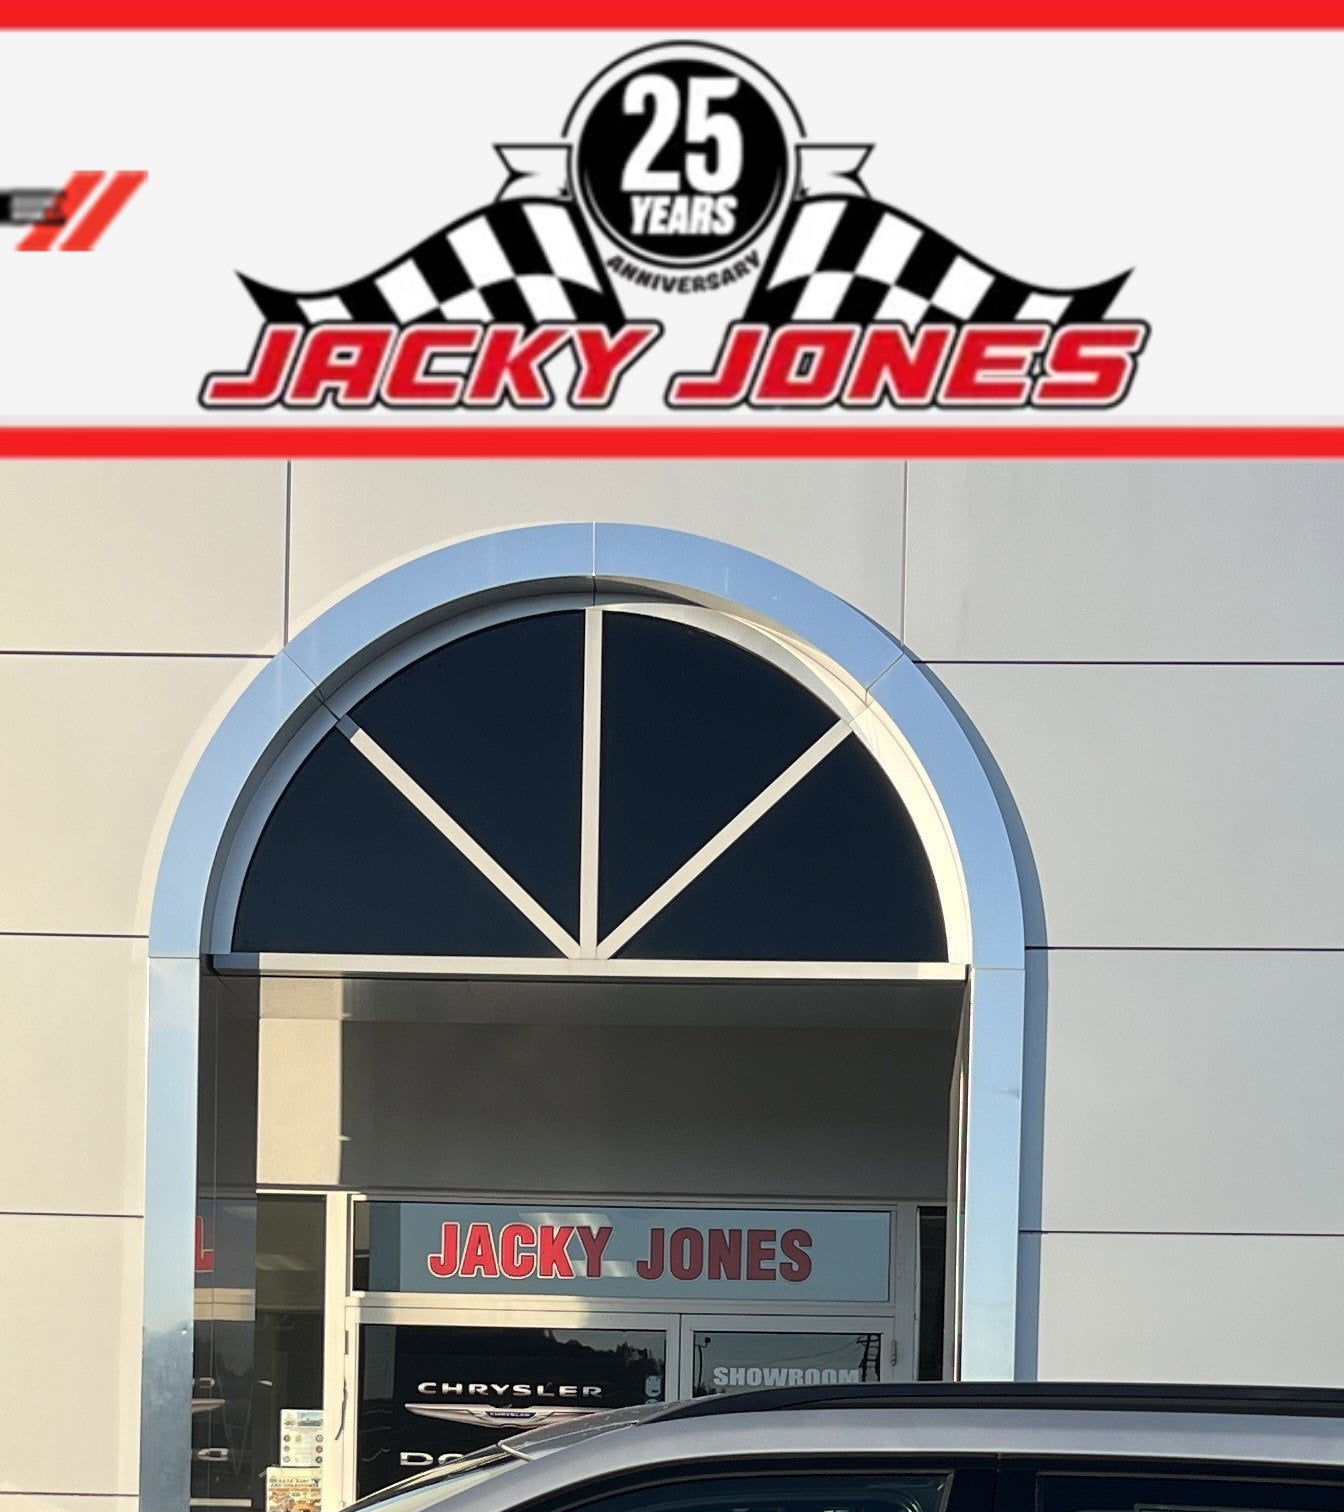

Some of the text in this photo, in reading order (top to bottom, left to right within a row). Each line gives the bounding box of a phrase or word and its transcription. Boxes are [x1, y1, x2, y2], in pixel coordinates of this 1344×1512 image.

[428, 1221, 813, 1284] JACKY JONES
[713, 1366, 861, 1387] SHOWROOM
[417, 1382, 603, 1398] CHRYSLER
